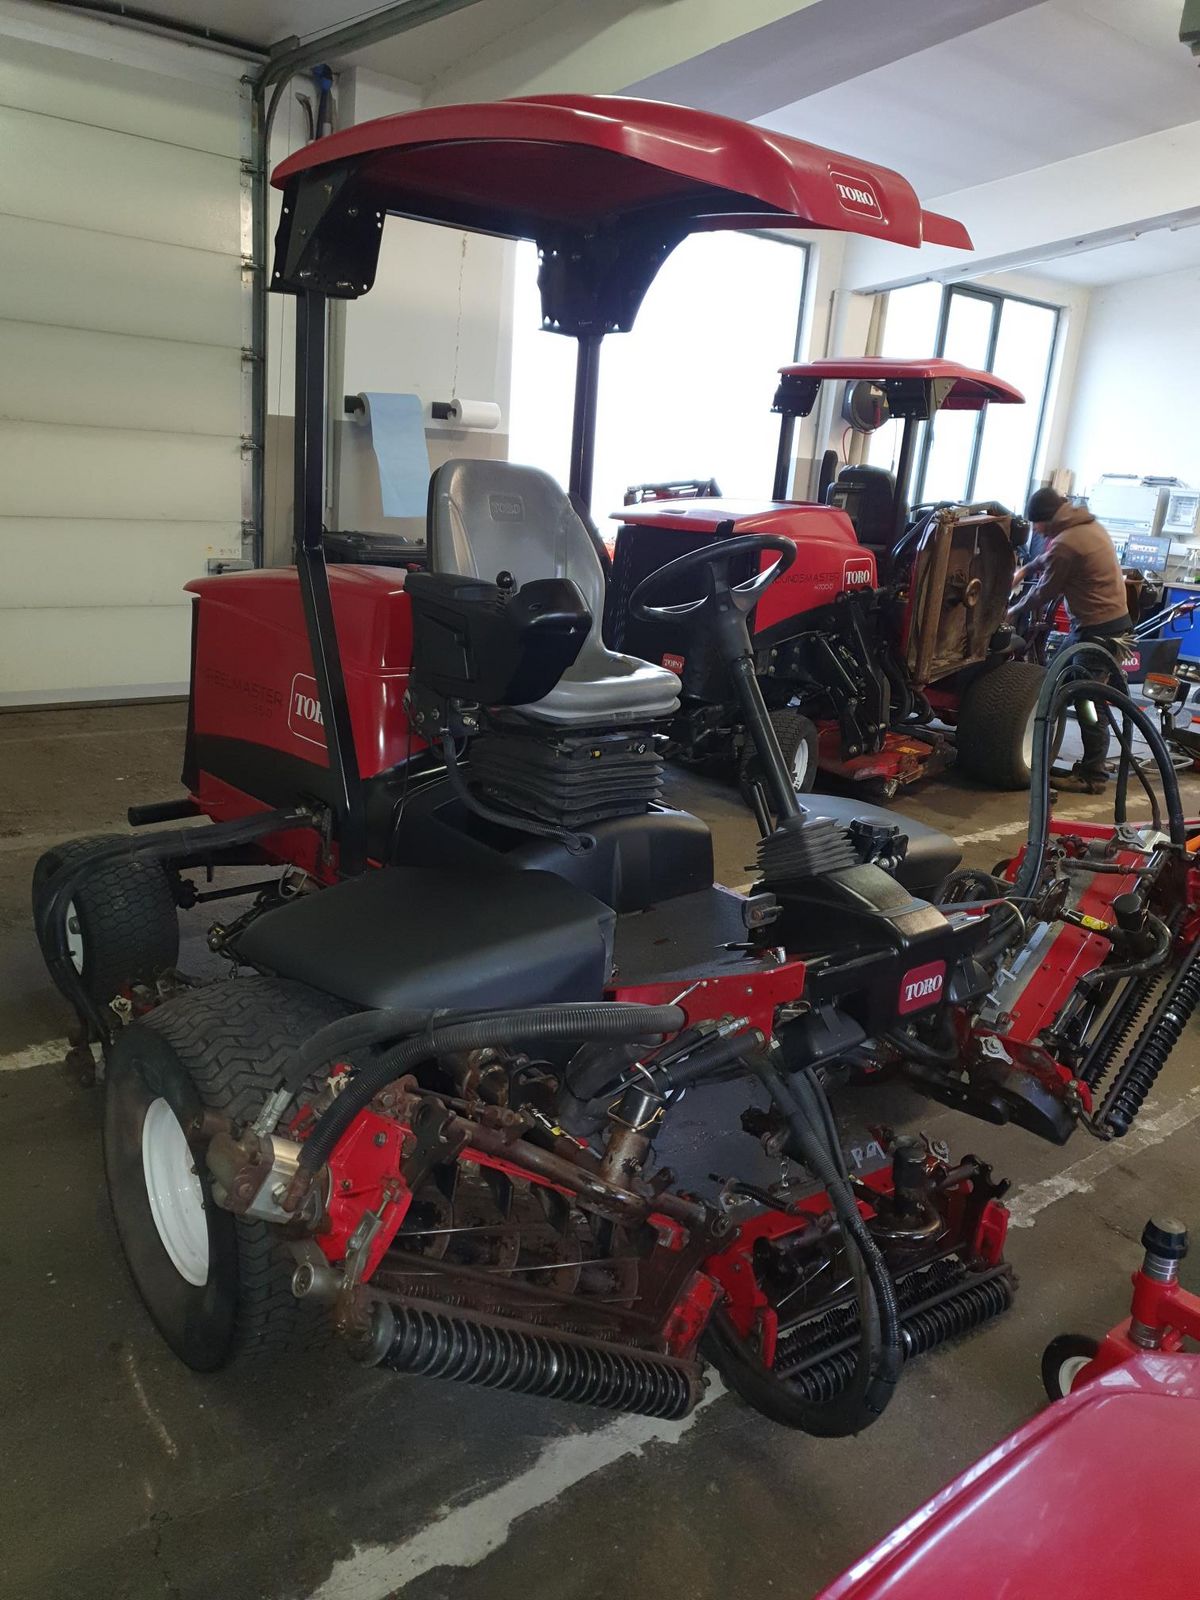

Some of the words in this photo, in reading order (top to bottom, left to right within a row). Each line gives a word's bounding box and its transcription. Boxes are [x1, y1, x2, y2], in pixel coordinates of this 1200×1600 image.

[836, 183, 874, 206] TORO
[846, 569, 870, 585] TORO
[905, 974, 943, 1002] TORO
